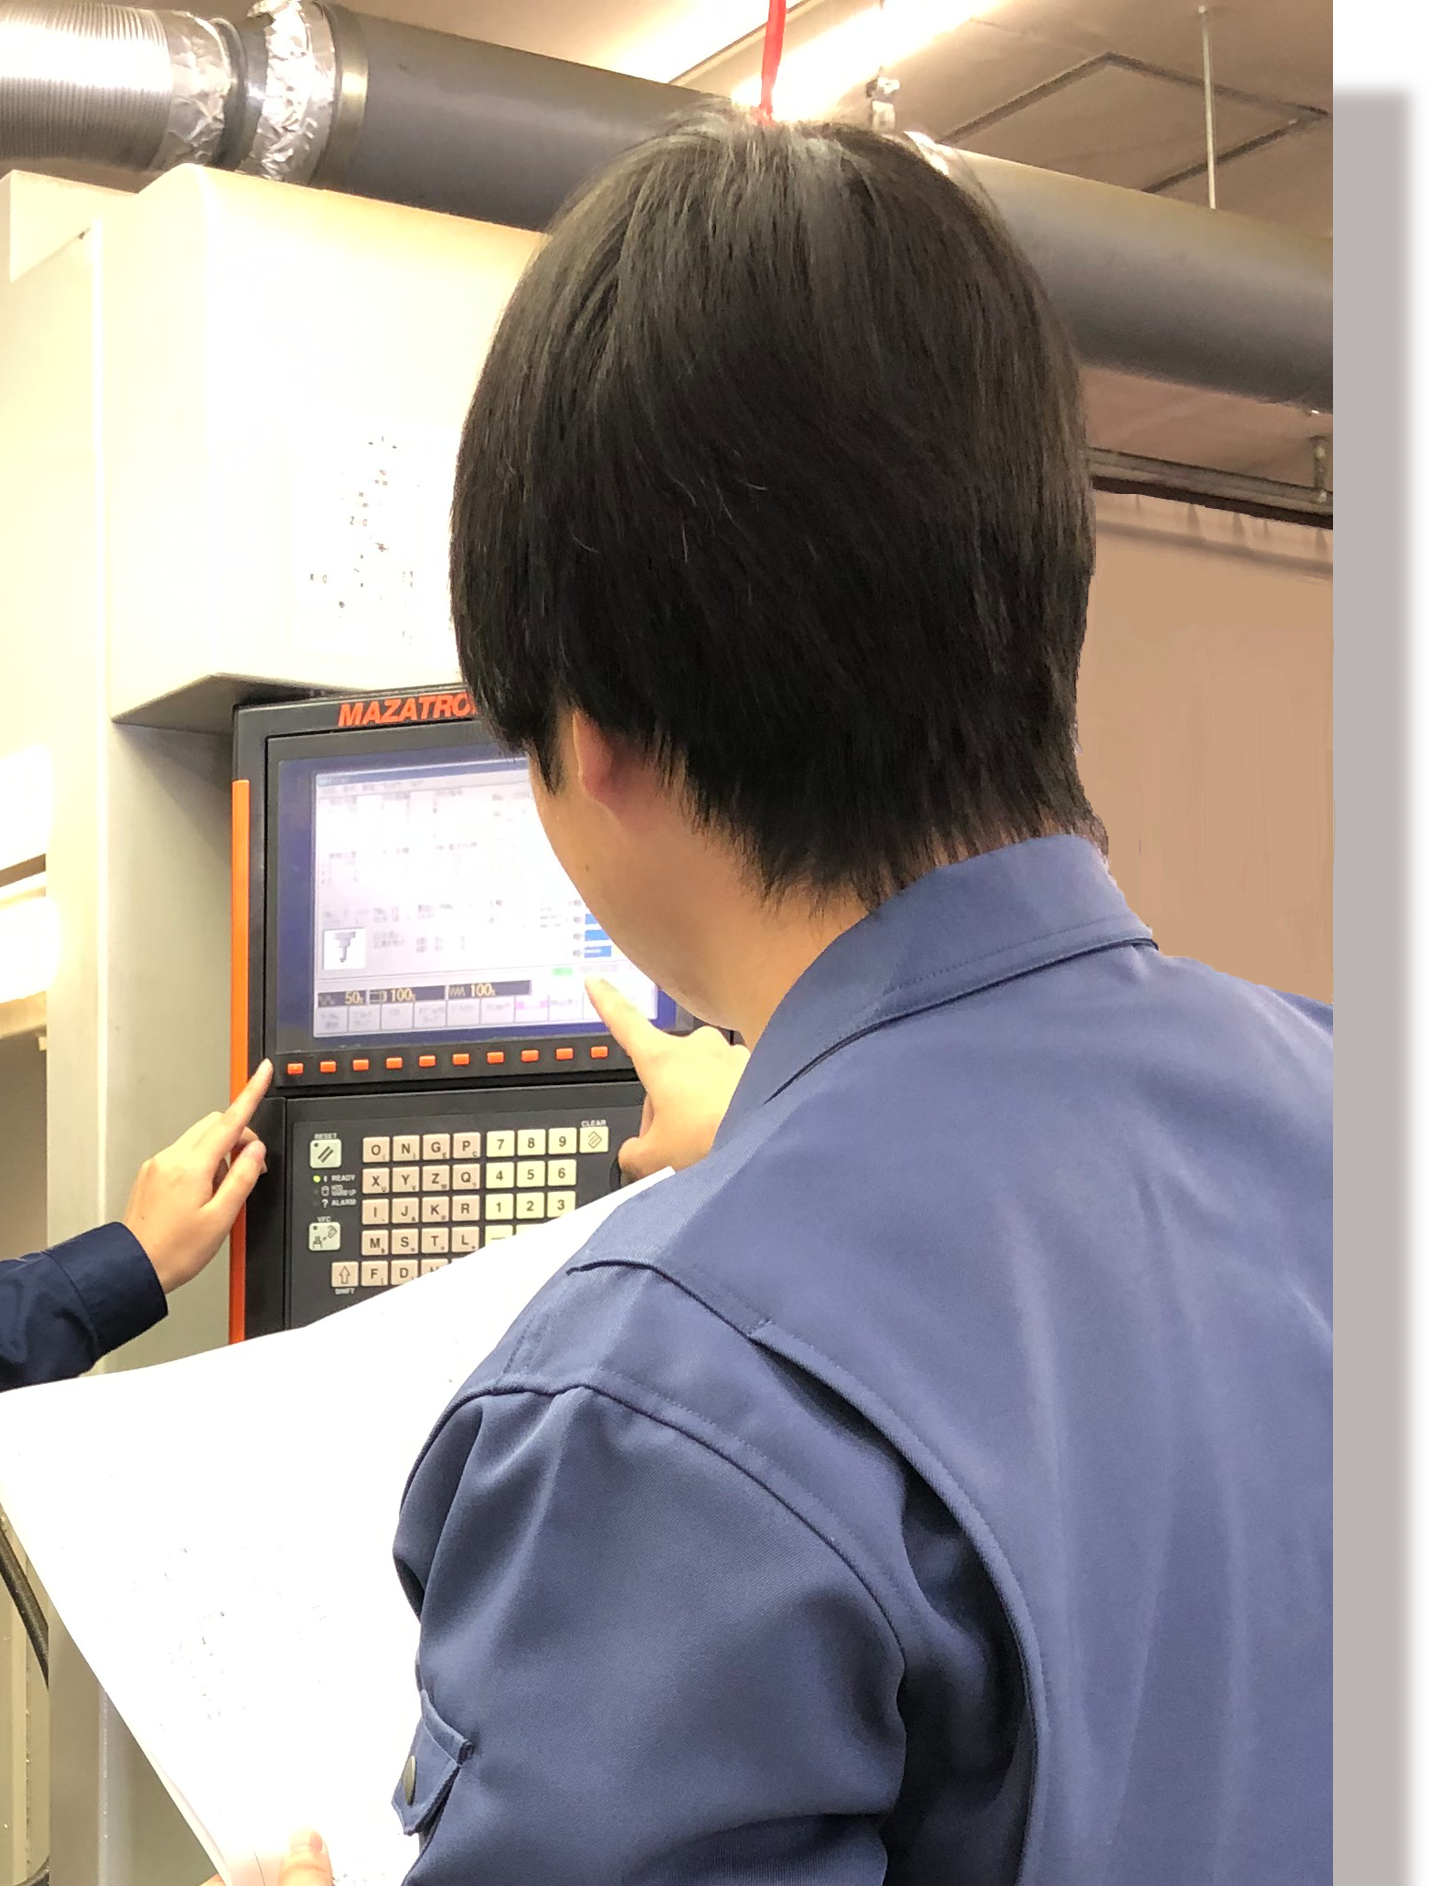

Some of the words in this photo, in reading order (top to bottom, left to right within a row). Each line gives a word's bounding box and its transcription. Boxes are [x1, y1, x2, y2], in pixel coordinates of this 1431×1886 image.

[338, 691, 476, 727] MAZATRO
[581, 1119, 606, 1127] CLEAR
[314, 1132, 337, 1140] RESET
[401, 1143, 411, 1154] N
[431, 1141, 441, 1153] G
[462, 1140, 471, 1151] P
[497, 1139, 504, 1150] 7
[528, 1137, 535, 1148] 8
[559, 1136, 566, 1147] 9
[371, 1176, 380, 1187] X
[401, 1174, 410, 1185] Y
[431, 1173, 440, 1184] Z
[461, 1171, 471, 1183] Q
[496, 1171, 503, 1181] 4
[527, 1169, 534, 1180] 5
[558, 1167, 566, 1178] 6
[331, 1198, 357, 1206] ALARM
[401, 1205, 409, 1217] J
[430, 1204, 440, 1215] K
[461, 1203, 470, 1214] R
[496, 1202, 501, 1212] 1
[526, 1201, 534, 1212] 2
[557, 1200, 565, 1210] 3
[370, 1238, 380, 1249] M
[400, 1236, 409, 1248] S
[431, 1235, 439, 1246] T
[461, 1234, 469, 1245] L
[371, 1268, 378, 1279] F
[399, 1267, 409, 1278] D
